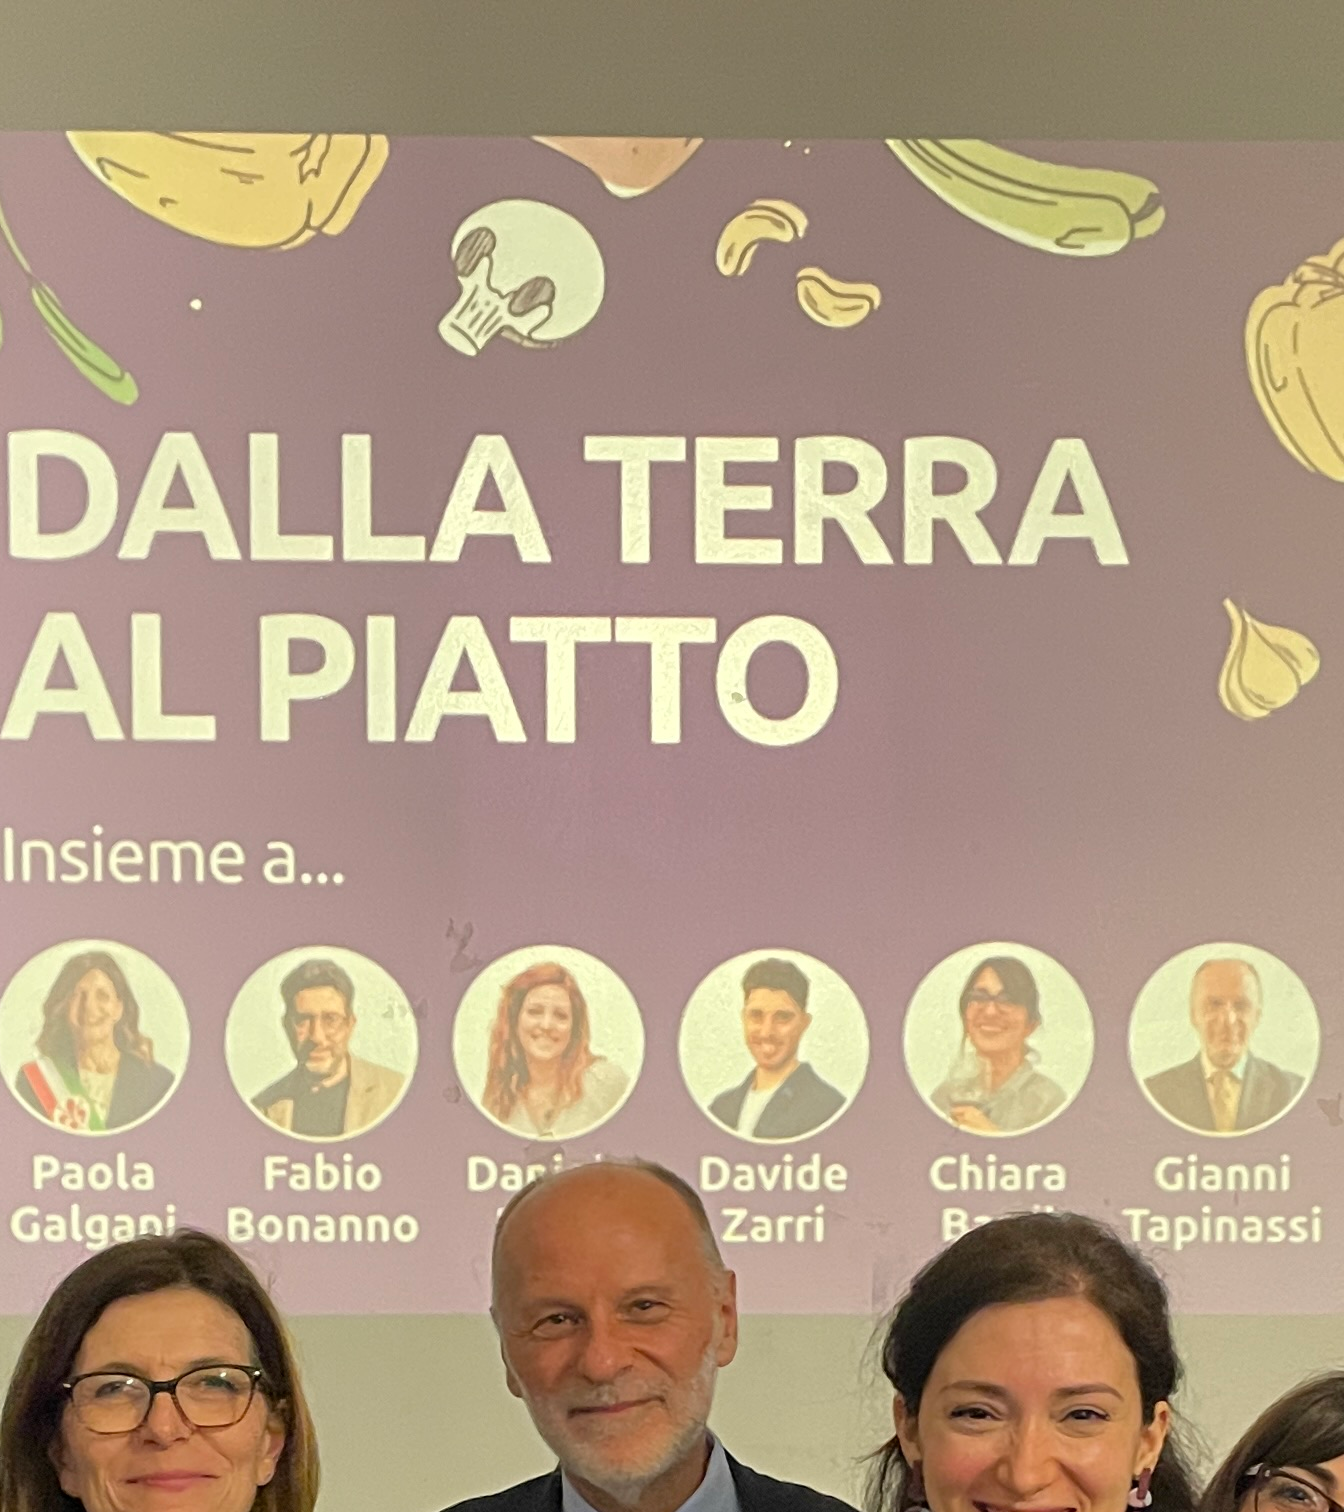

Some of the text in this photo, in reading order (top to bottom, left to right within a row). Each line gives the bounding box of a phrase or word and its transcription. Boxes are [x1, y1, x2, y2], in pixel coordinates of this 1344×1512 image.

[8, 430, 1130, 567] DALLA TERRA
[0, 613, 840, 748] AL PIATTO
[5, 825, 346, 885] Insieme a...
[32, 1153, 156, 1192] Paola
[265, 1153, 383, 1192] Fabio
[701, 1154, 849, 1193] Davide
[931, 1154, 1067, 1193] Chiara
[1156, 1155, 1291, 1193] Gianni
[11, 1204, 177, 1252] Galgani
[228, 1208, 420, 1244] Bonanno
[722, 1205, 826, 1244] Zarri
[1123, 1206, 1322, 1252] Tapinassi
